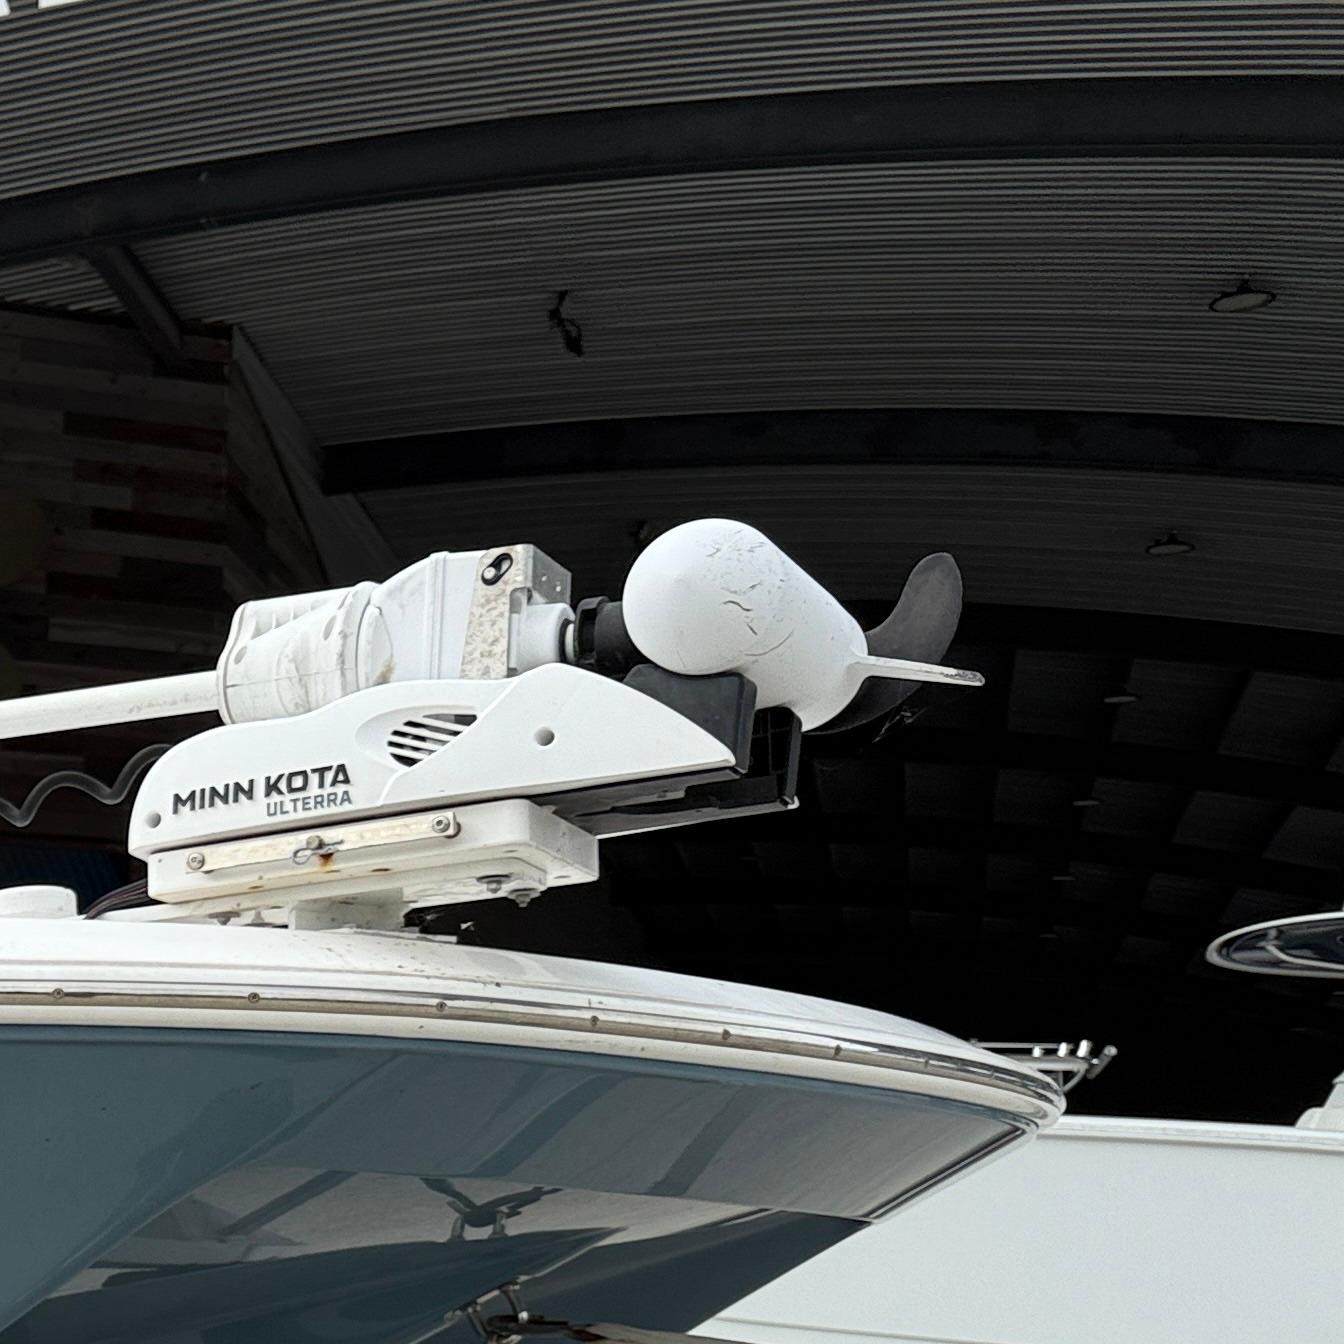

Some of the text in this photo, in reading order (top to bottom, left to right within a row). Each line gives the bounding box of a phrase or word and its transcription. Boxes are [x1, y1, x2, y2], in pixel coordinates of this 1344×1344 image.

[172, 763, 353, 815] MINN KOTA
[266, 790, 353, 817] ULTERRA
